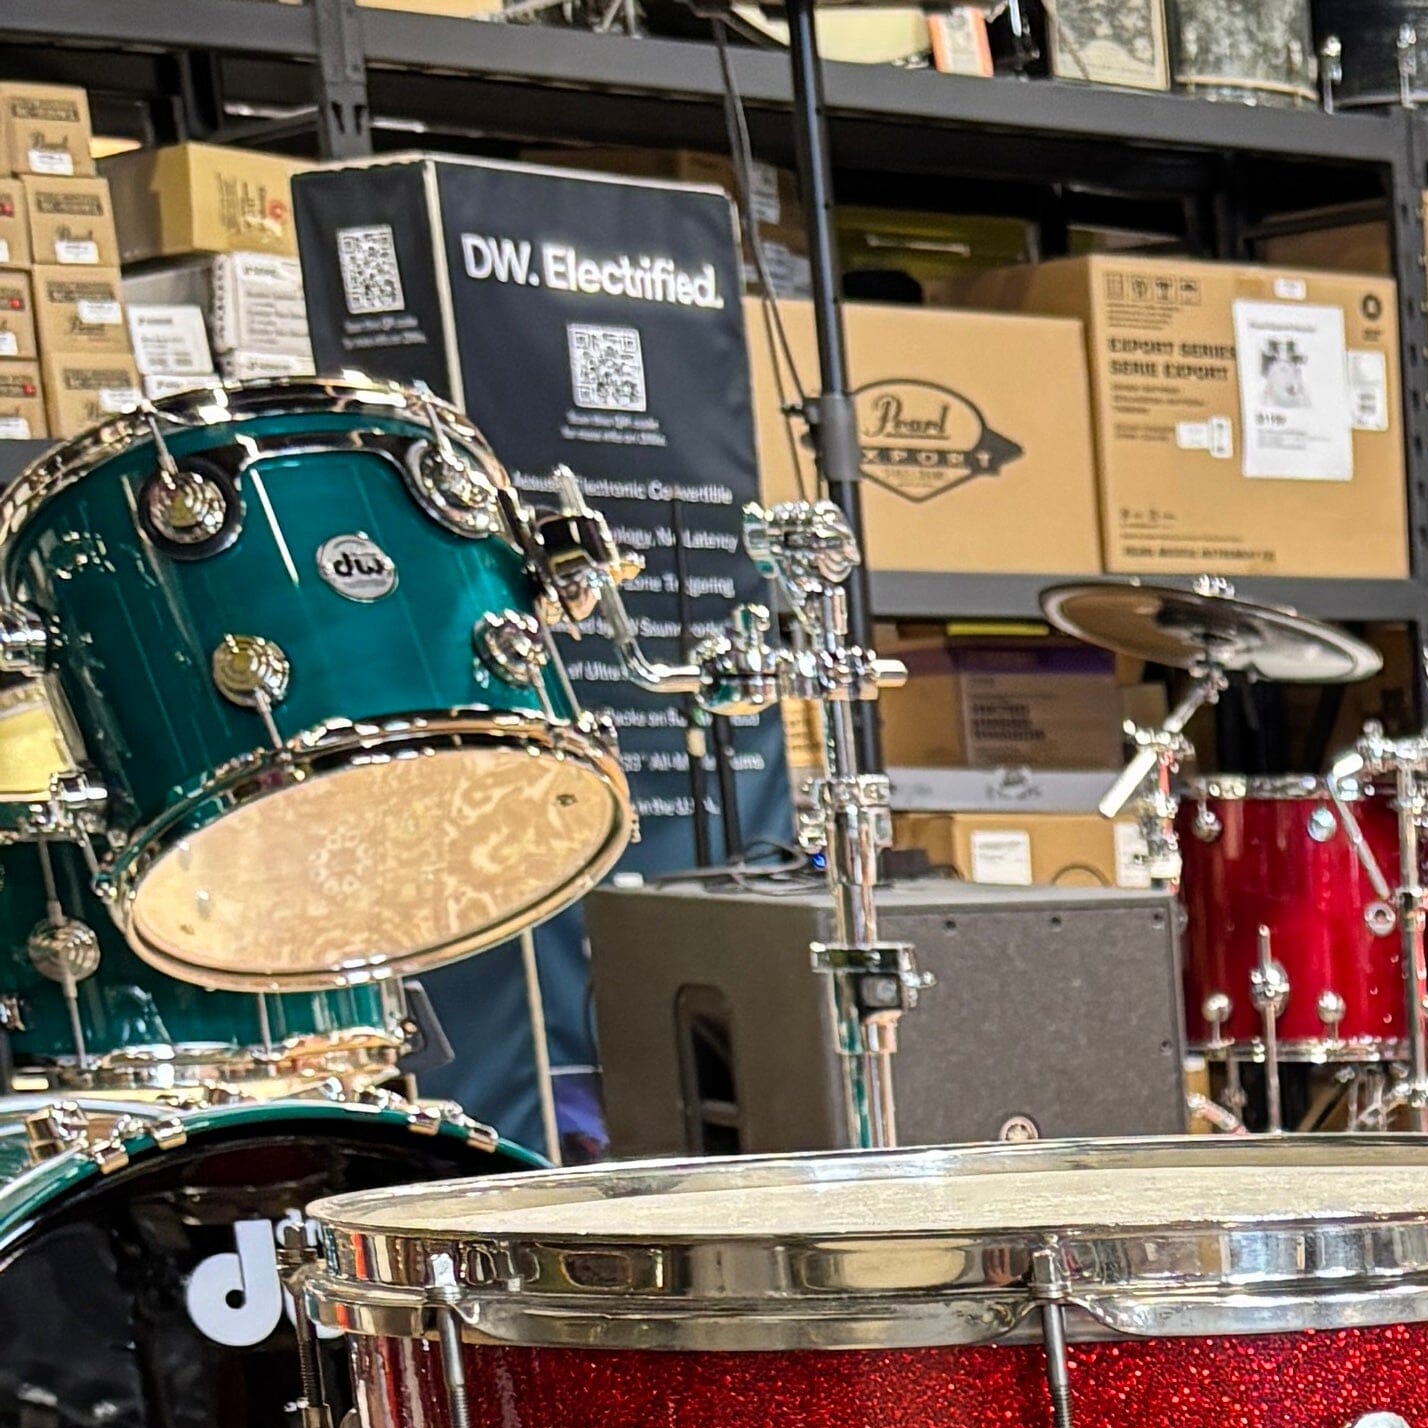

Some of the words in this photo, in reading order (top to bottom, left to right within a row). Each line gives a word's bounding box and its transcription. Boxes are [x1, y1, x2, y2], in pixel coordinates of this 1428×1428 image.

[461, 232, 540, 287] DW.
[542, 243, 725, 310] Electrified.
[864, 393, 951, 441] Pearl
[863, 450, 992, 469] XPORT
